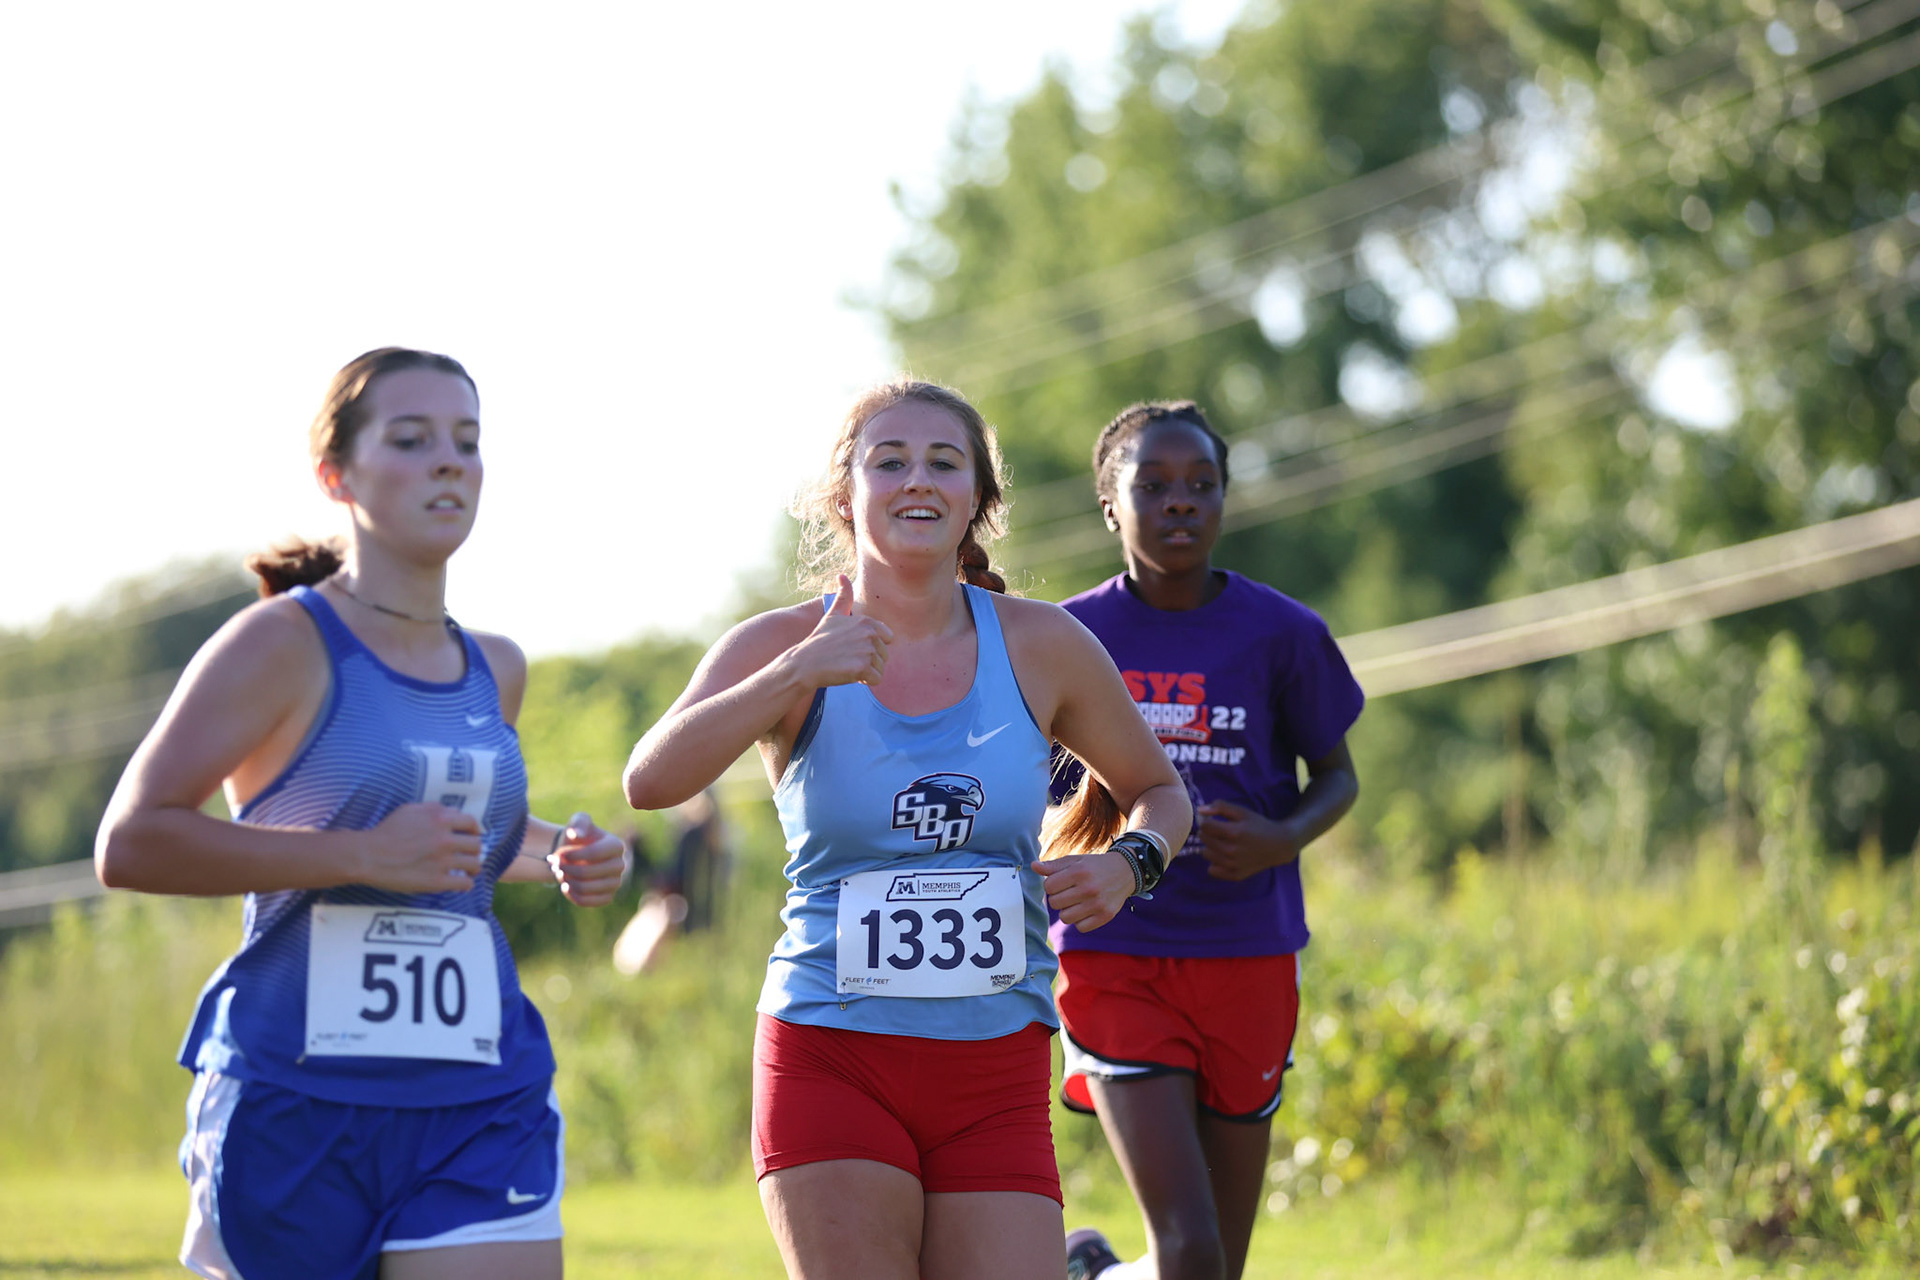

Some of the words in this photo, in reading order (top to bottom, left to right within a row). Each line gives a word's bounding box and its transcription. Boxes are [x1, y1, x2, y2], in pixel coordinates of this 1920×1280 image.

[1211, 706, 1246, 730] 22
[404, 743, 498, 834] H
[896, 792, 971, 850] SBA
[861, 907, 1004, 970] 1333
[359, 953, 467, 1027] 510
